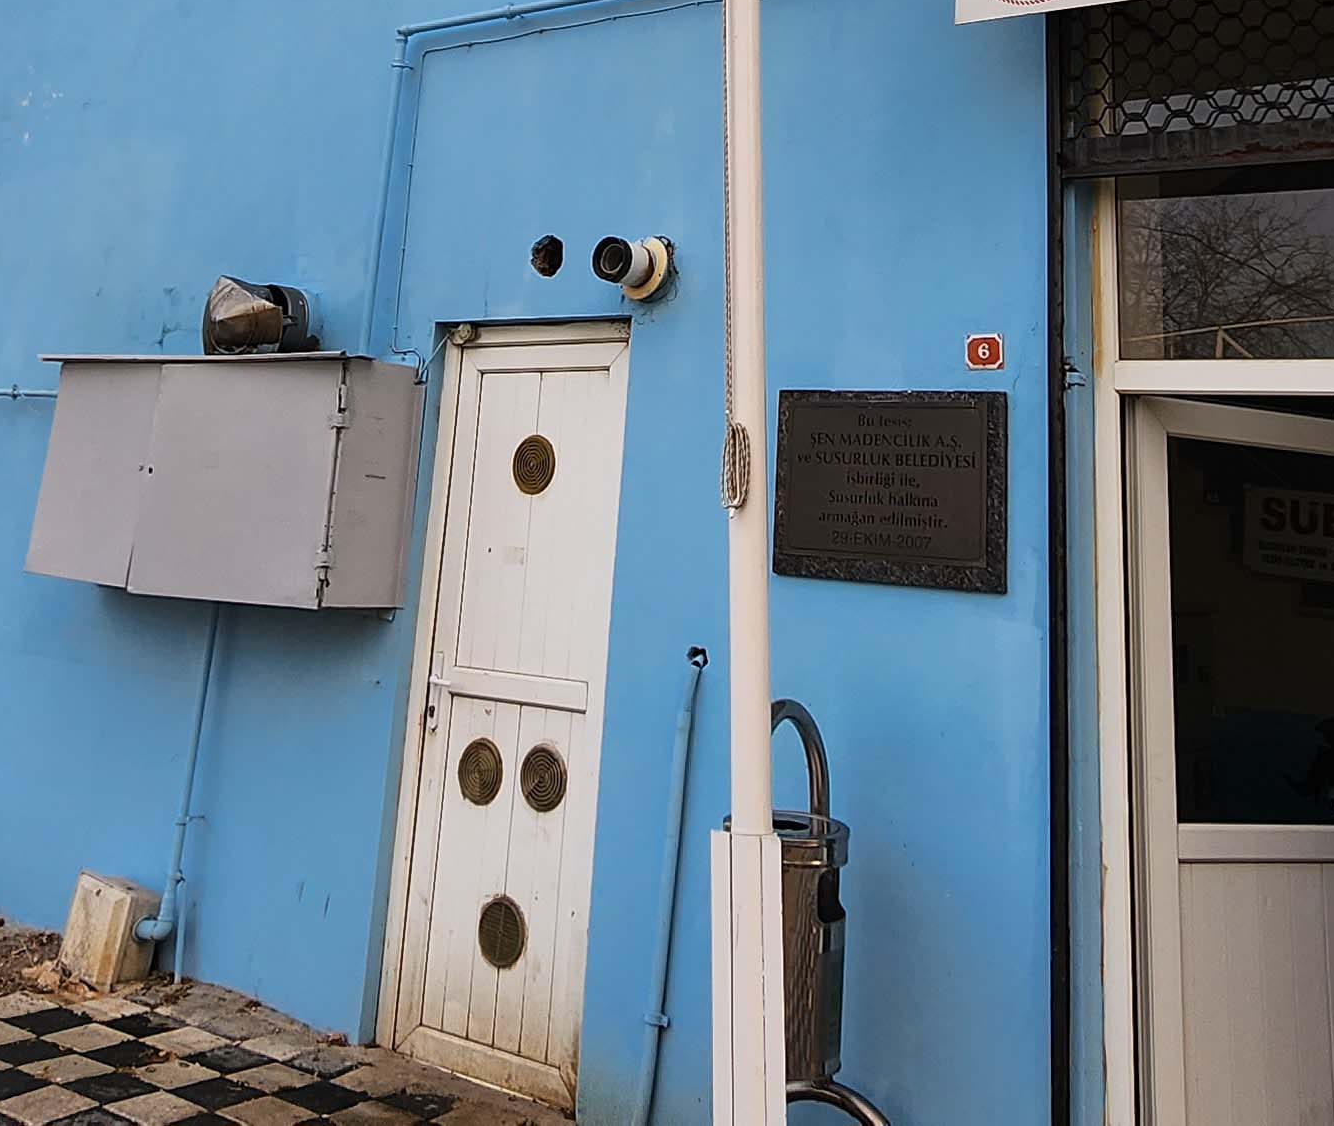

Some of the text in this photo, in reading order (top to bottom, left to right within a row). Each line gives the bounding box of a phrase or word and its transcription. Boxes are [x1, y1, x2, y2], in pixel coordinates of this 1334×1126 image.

[978, 343, 990, 361] 6
[810, 433, 836, 452] ŞEN
[816, 452, 891, 467] SUSURLUK
[895, 452, 977, 469] BELEDİYESİ
